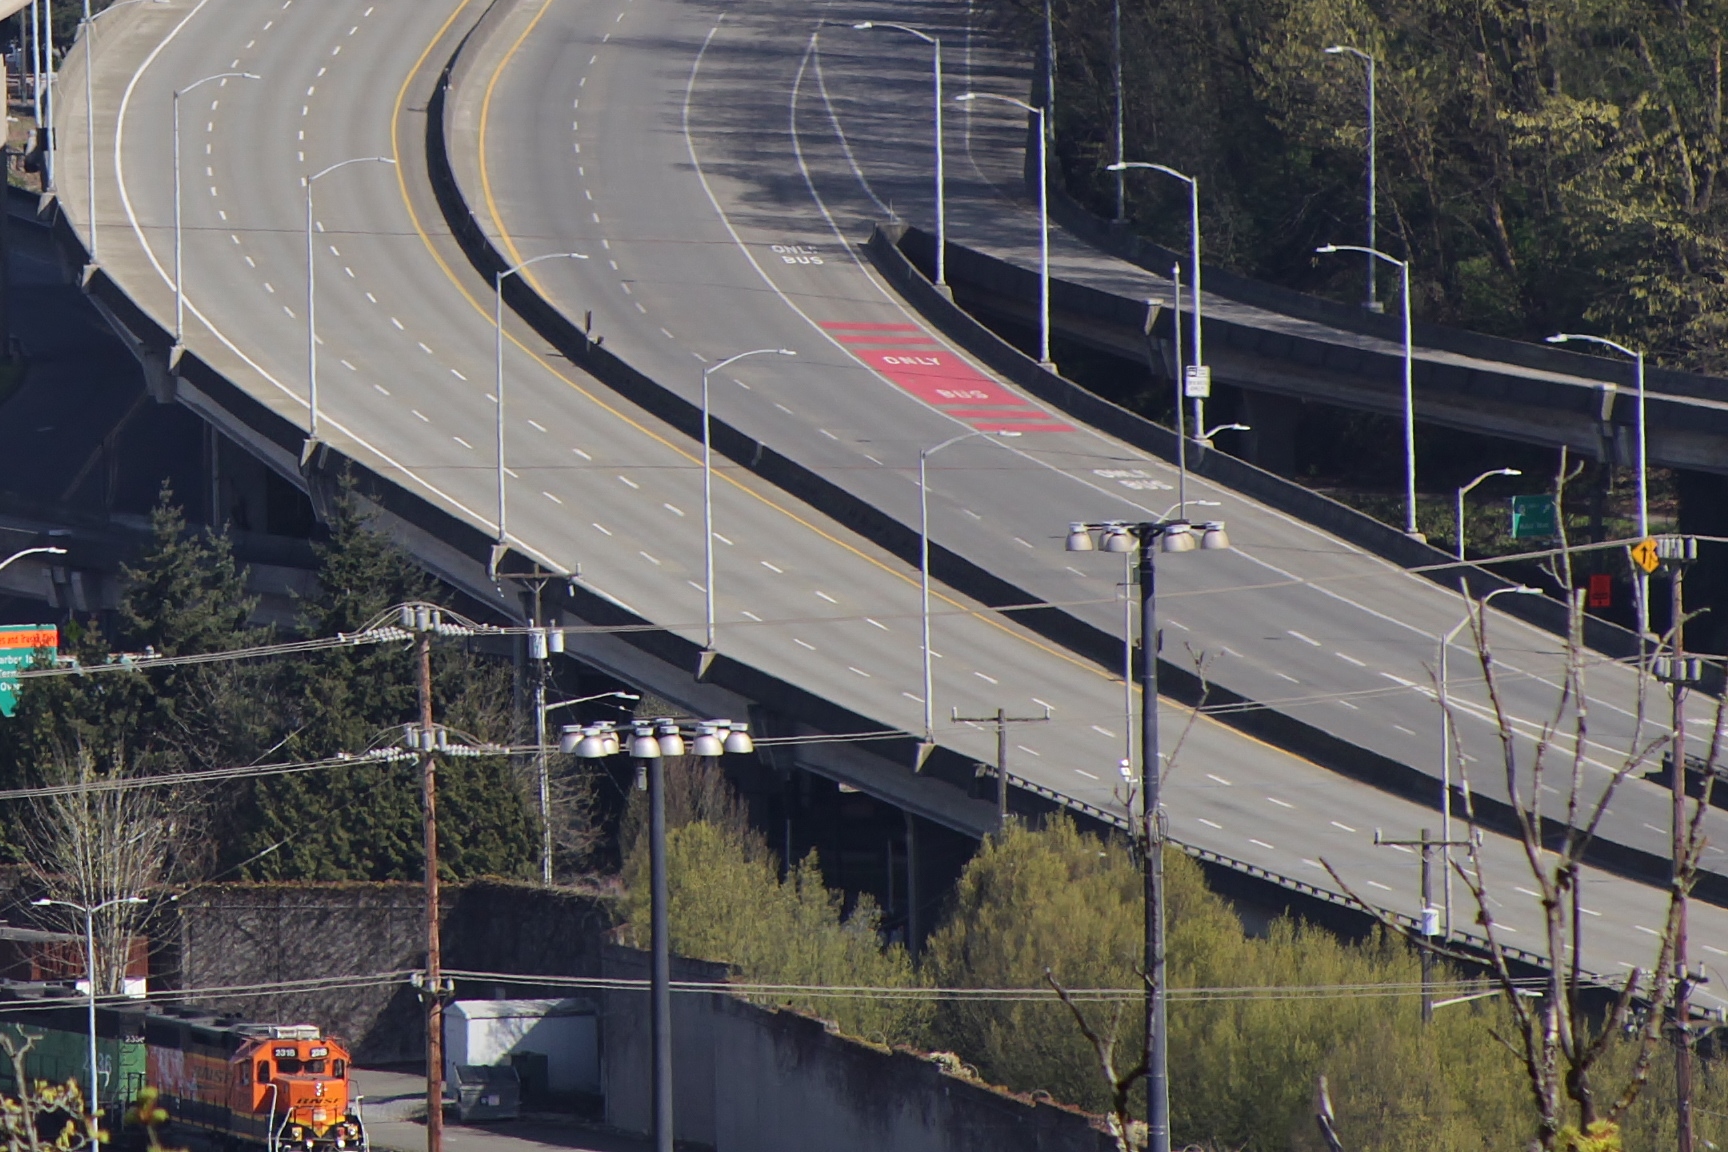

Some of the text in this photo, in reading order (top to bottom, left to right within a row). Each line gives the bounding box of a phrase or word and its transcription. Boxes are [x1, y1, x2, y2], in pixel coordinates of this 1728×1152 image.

[782, 256, 824, 265] BUS
[883, 356, 940, 366] ONLY
[936, 389, 989, 399] BUS
